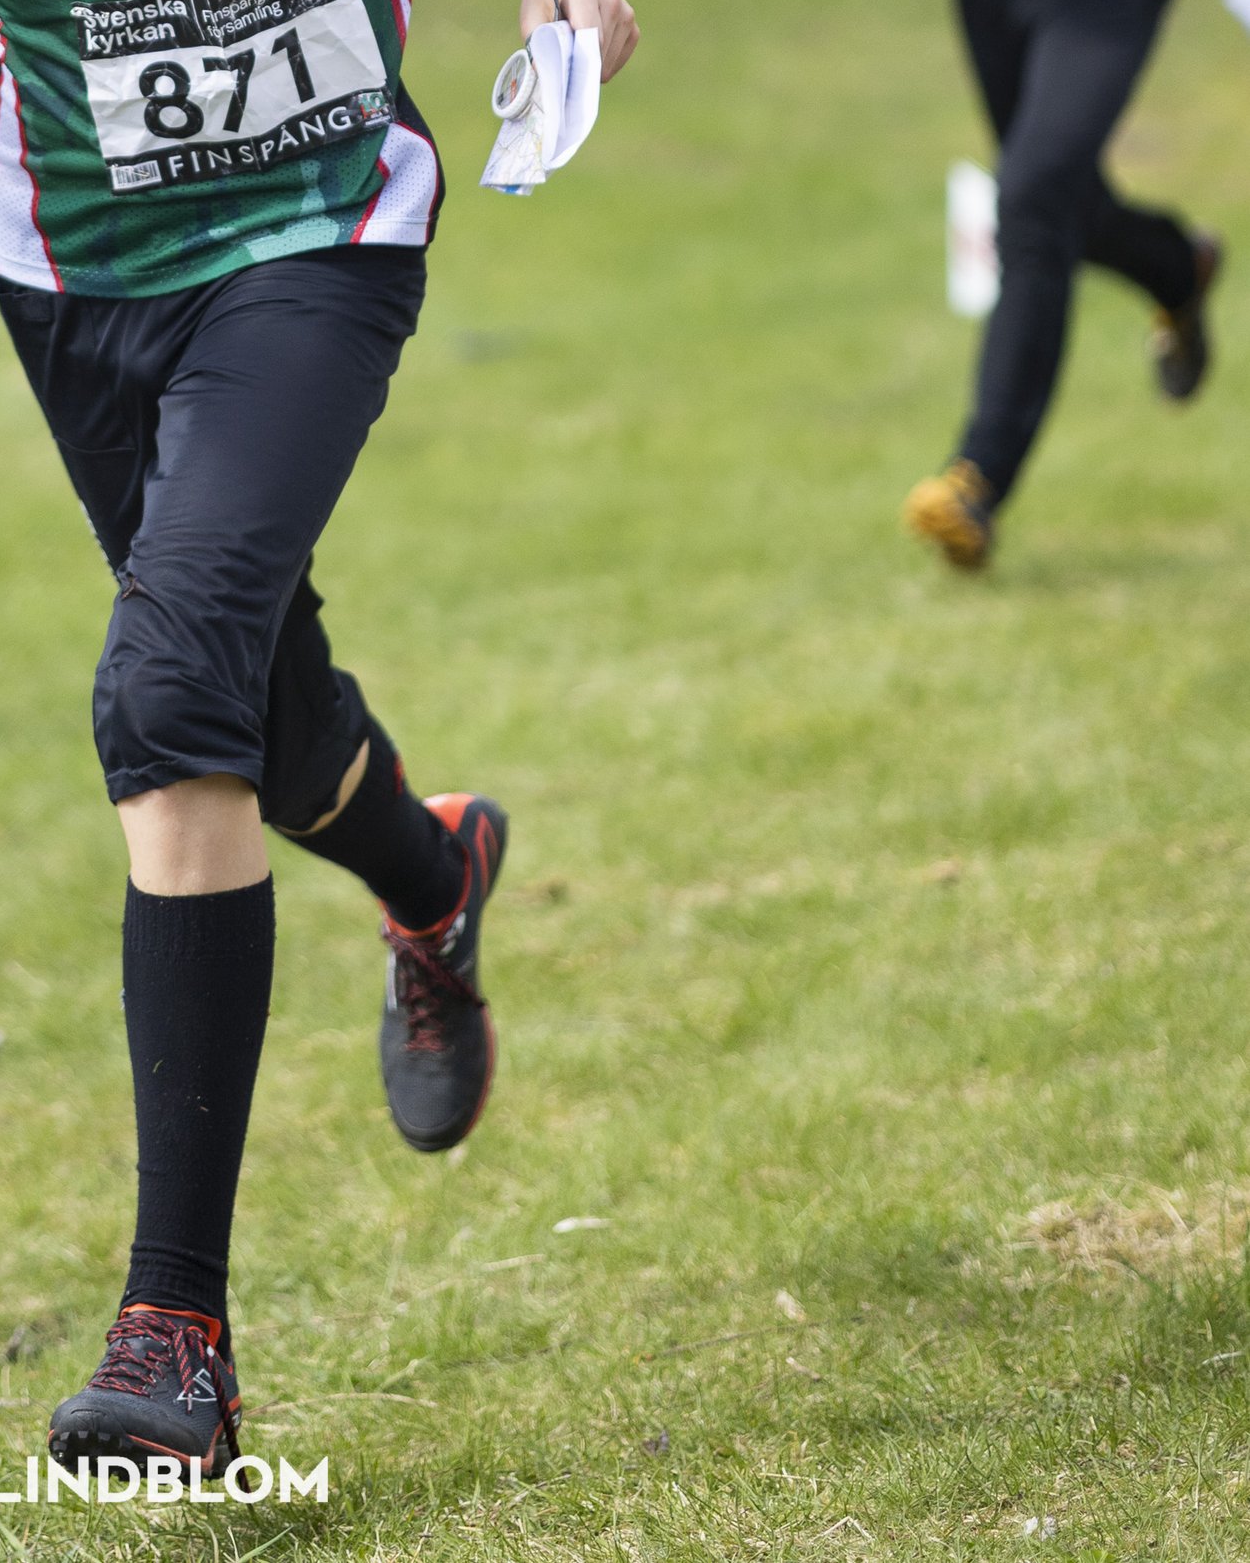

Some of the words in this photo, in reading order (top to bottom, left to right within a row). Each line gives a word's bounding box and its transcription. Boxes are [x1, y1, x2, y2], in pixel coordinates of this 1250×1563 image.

[85, 22, 176, 54] kyrkan
[207, 0, 284, 39] församling
[139, 27, 316, 139] 871
[168, 105, 352, 178] FINSPÅNG
